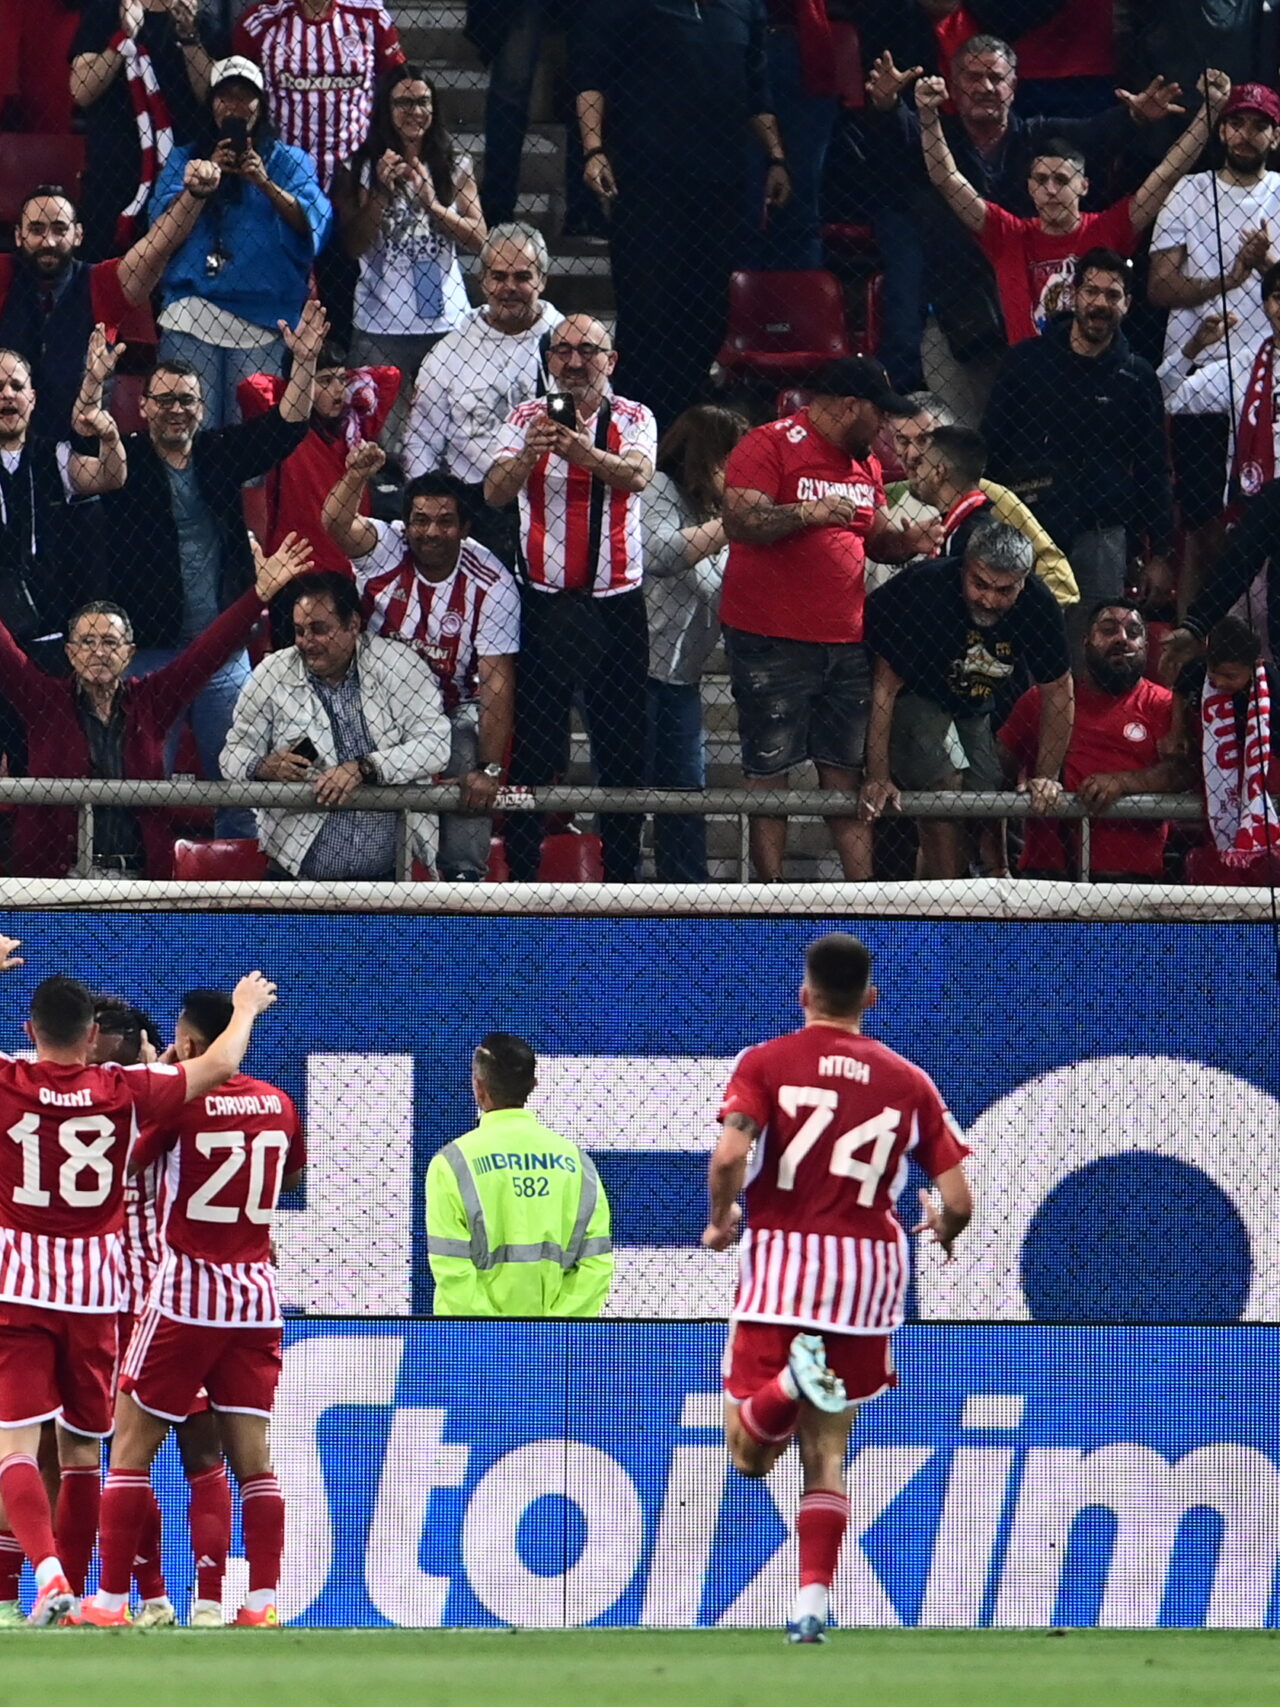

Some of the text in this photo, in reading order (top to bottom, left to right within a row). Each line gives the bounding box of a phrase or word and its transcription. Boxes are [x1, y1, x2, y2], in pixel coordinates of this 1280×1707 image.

[39, 1088, 93, 1107] QUINI
[205, 1095, 283, 1117] CARVALHO
[776, 1084, 903, 1208] 74
[6, 1112, 117, 1208] 18
[490, 1152, 577, 1174] BRINKS
[186, 1130, 289, 1225] 20
[512, 1176, 551, 1198] 582
